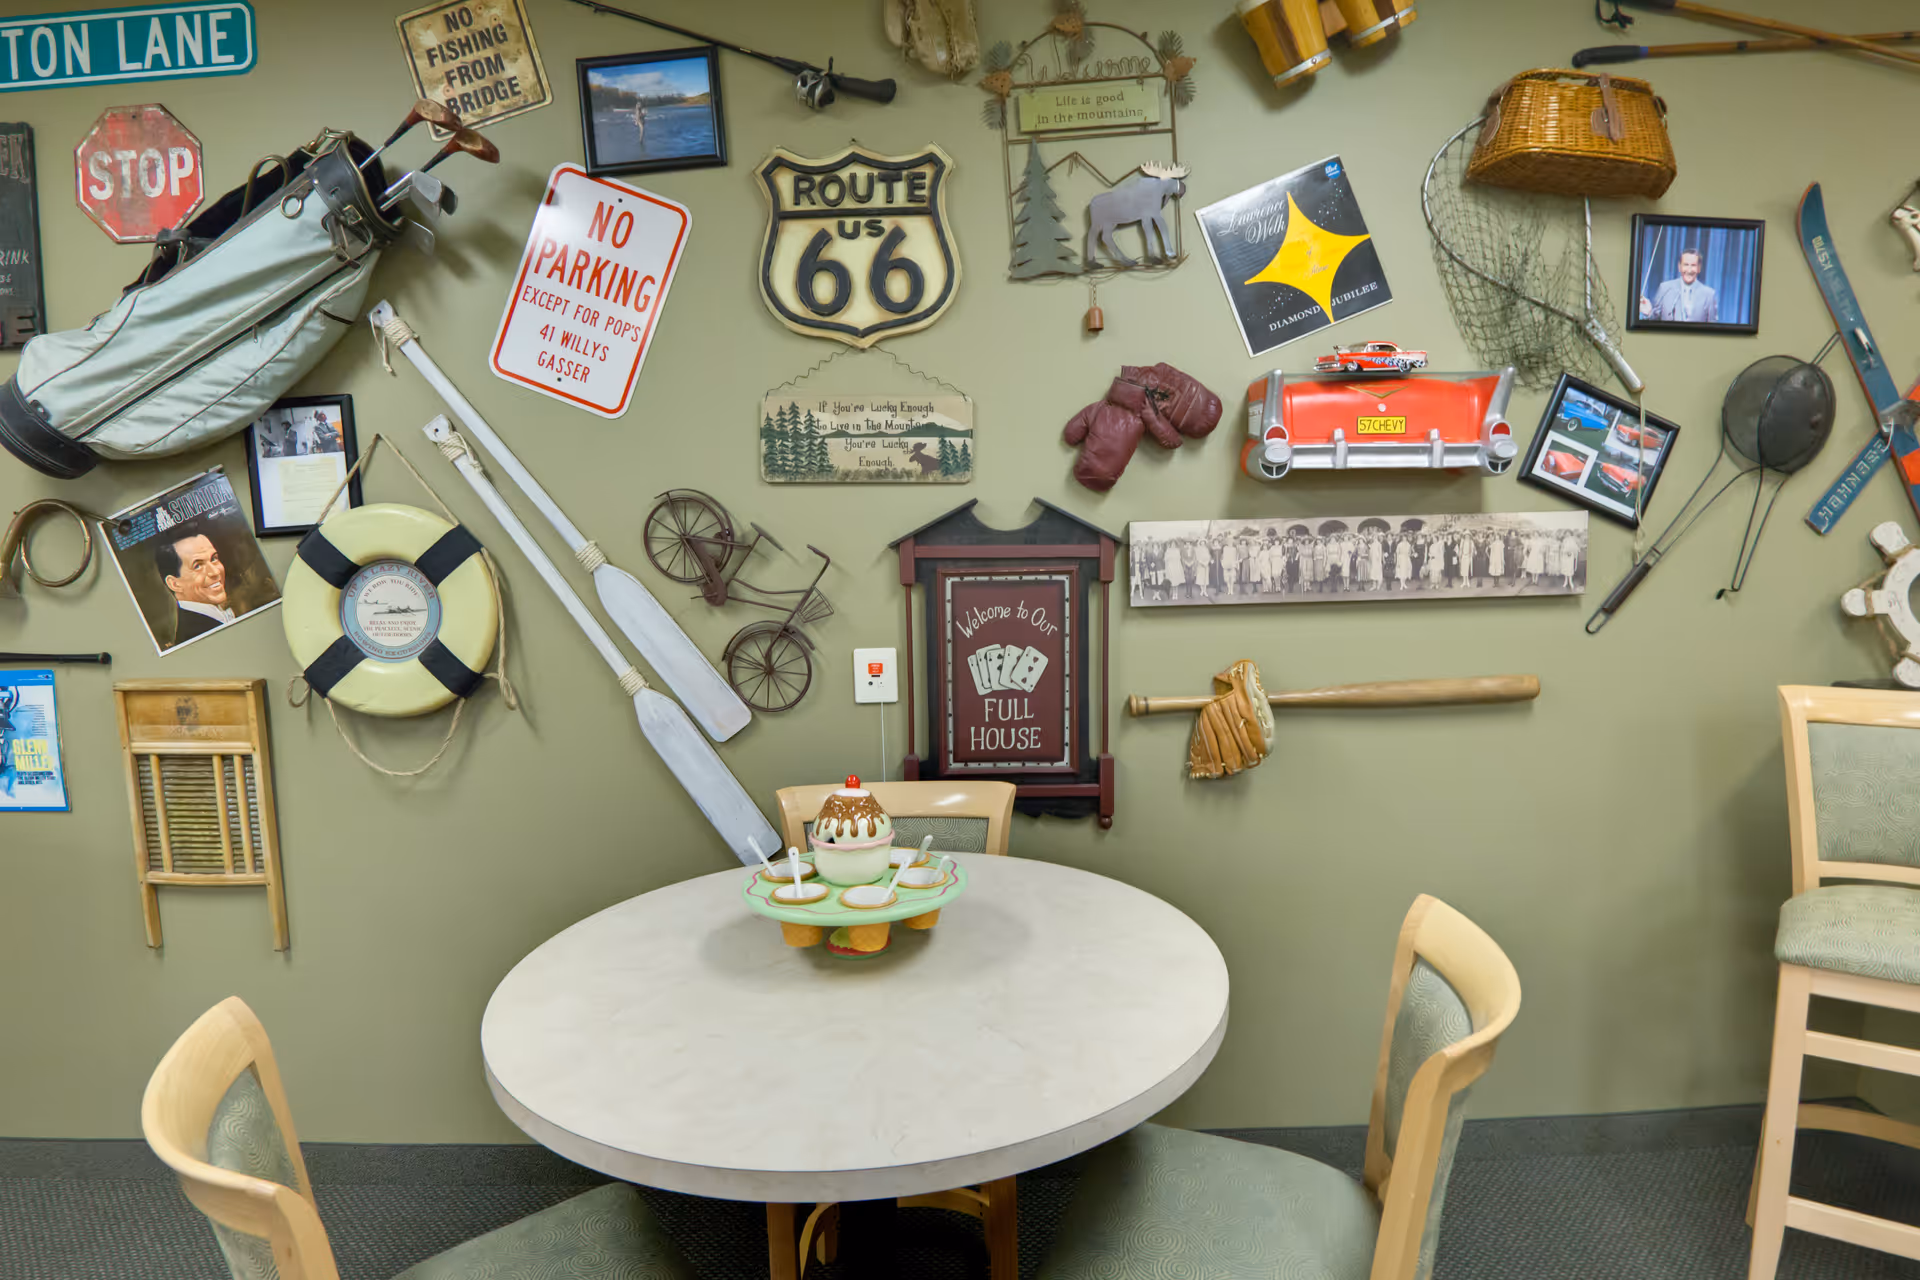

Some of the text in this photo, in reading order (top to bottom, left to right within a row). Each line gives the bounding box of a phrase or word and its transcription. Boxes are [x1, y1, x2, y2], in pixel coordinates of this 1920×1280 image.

[443, 6, 474, 33] NO
[1, 11, 235, 81] TON LANE
[425, 23, 509, 68] FISHING
[444, 53, 506, 89] FROM
[445, 76, 522, 116] BRIDGE
[1055, 90, 1125, 108] Life is good
[1036, 113, 1050, 125] in
[1053, 110, 1074, 123] the
[88, 147, 194, 200] STOP
[793, 171, 927, 207] ROUTE
[587, 200, 635, 249] NO
[837, 218, 886, 240] US
[534, 237, 656, 313] PARKING
[796, 225, 925, 317] 66
[522, 284, 642, 343] EXCEPT FOR POP'S
[1268, 281, 1379, 332] DIAMOND JUBILEE
[539, 323, 610, 363] 41 WILLYS
[537, 350, 590, 384] GASSER
[816, 418, 827, 430] to
[830, 419, 850, 431] Live
[852, 421, 862, 431] in
[864, 417, 882, 431] the
[818, 401, 935, 418] If You're Lucky Enough
[1359, 418, 1405, 433] 57CHEVY
[844, 438, 909, 454] You're Lucky
[168, 482, 234, 525] SINATRA
[371, 565, 401, 575] LAZY
[956, 600, 1058, 639] Welcome to Our
[984, 698, 1034, 722] FULL
[970, 726, 1041, 751] HOUSE
